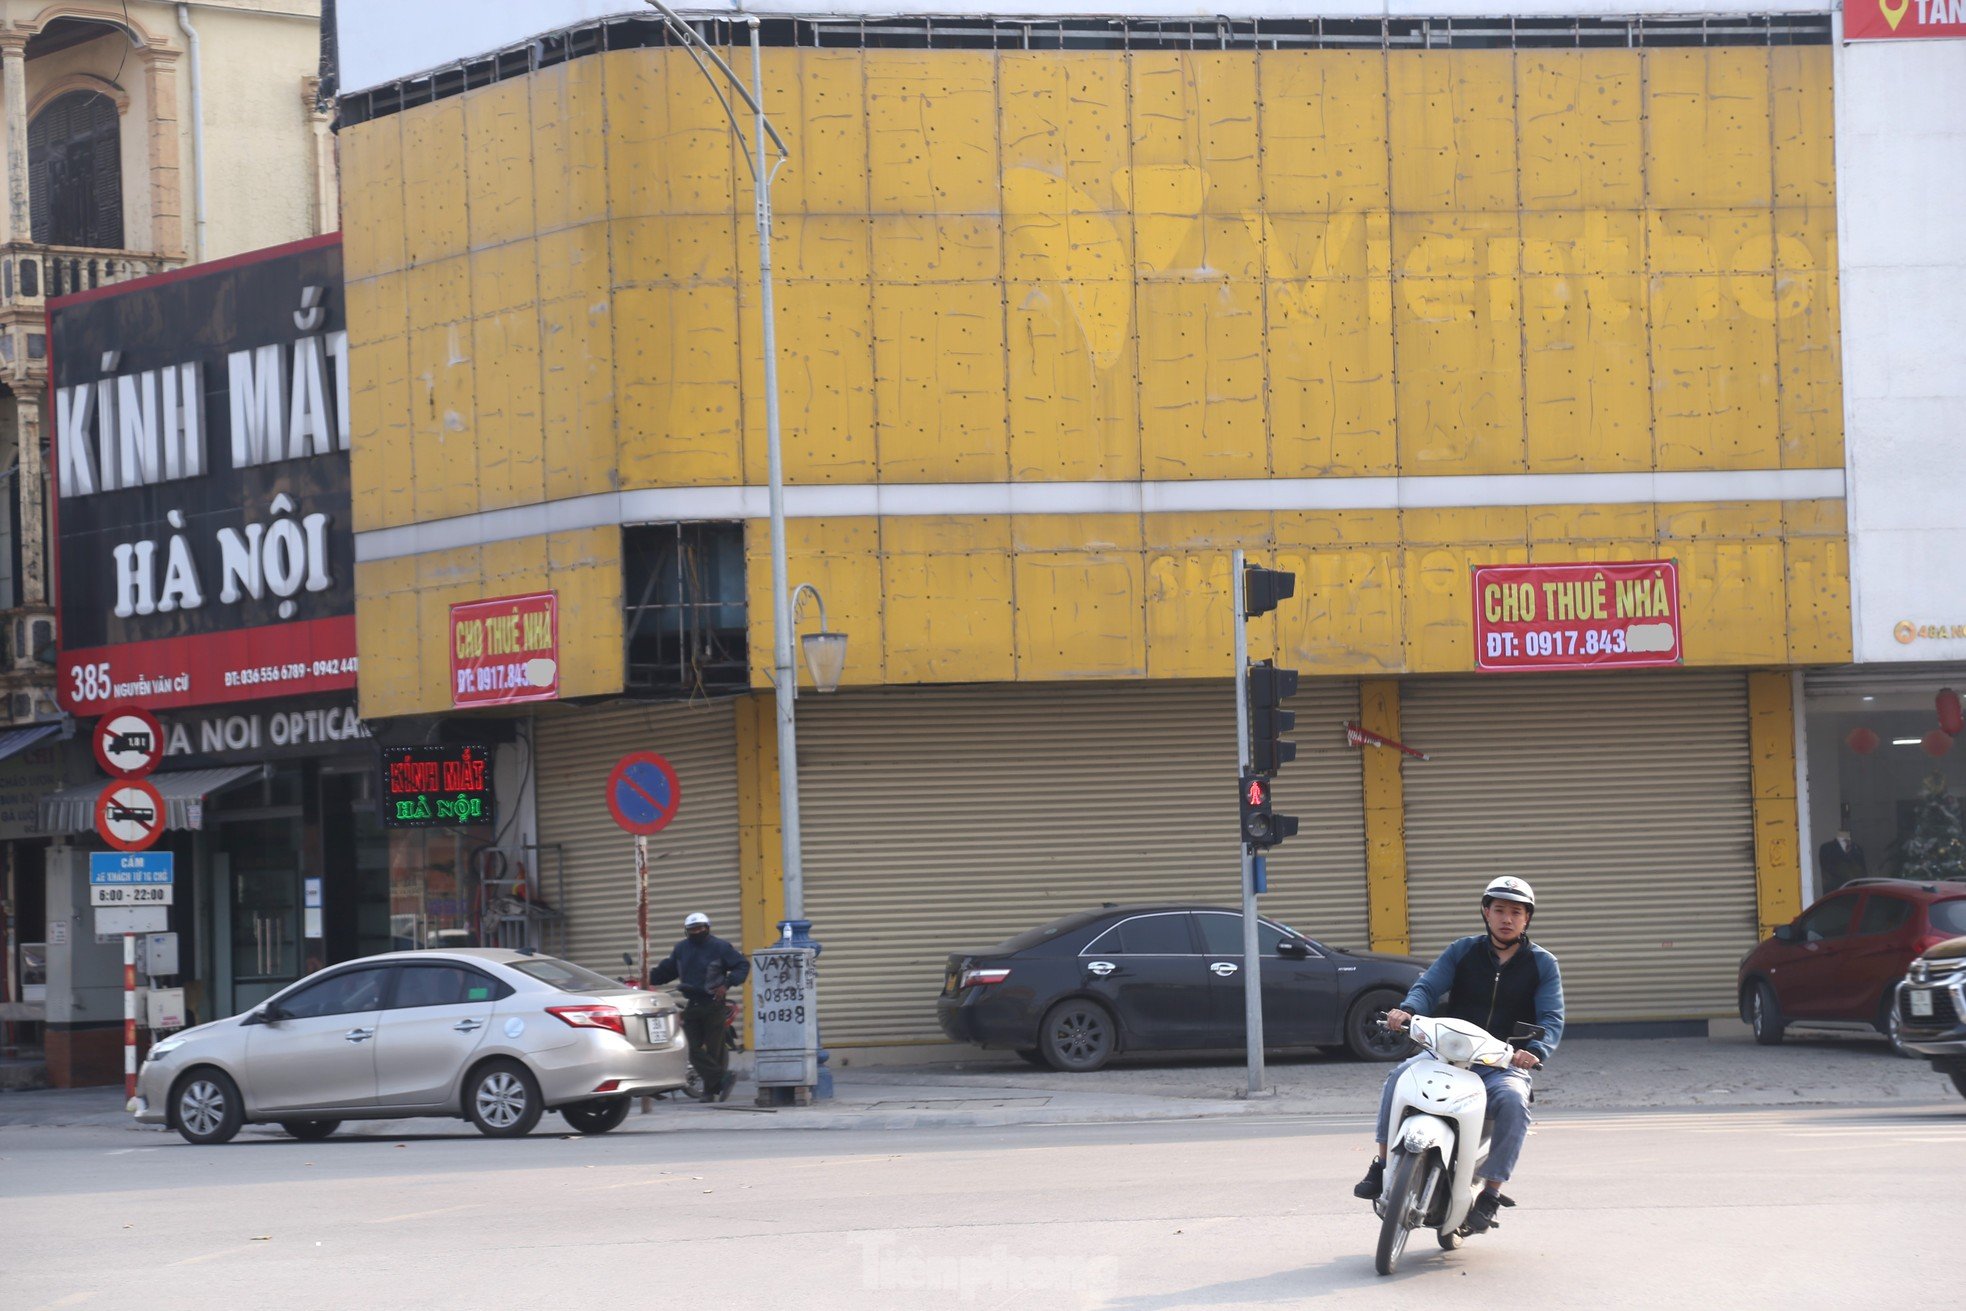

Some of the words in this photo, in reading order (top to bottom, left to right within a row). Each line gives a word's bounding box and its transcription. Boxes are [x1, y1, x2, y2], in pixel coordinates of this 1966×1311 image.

[57, 351, 206, 498] KÍNH
[228, 286, 350, 468] MẮT
[113, 509, 202, 617] HÀ
[217, 493, 331, 619] NỘI
[1484, 582, 1536, 623] CHO
[1543, 572, 1608, 621] THUÊ
[1615, 570, 1670, 619] NHÀ
[456, 619, 483, 659] CHO
[485, 606, 520, 655] THUÊ
[523, 602, 552, 651] NHÀ
[1487, 632, 1519, 658] ĐT:
[1526, 627, 1645, 657] 0917.843
[71, 662, 111, 702] 385
[114, 674, 150, 698] NGUYỄN
[151, 674, 172, 693] VĂN
[281, 663, 305, 680] 6789
[313, 659, 339, 676] 0942
[457, 668, 476, 693] ĐT:
[477, 662, 541, 691] 0917.843
[201, 715, 260, 753] NOI
[270, 706, 372, 746] OPTICA
[390, 754, 439, 792] KÍNH
[443, 748, 485, 791] MẮT
[396, 795, 431, 819] HÀ
[436, 793, 481, 822] NỘI
[121, 854, 144, 868] CẤM
[99, 889, 123, 901] 6:00
[134, 889, 164, 901] 22:00
